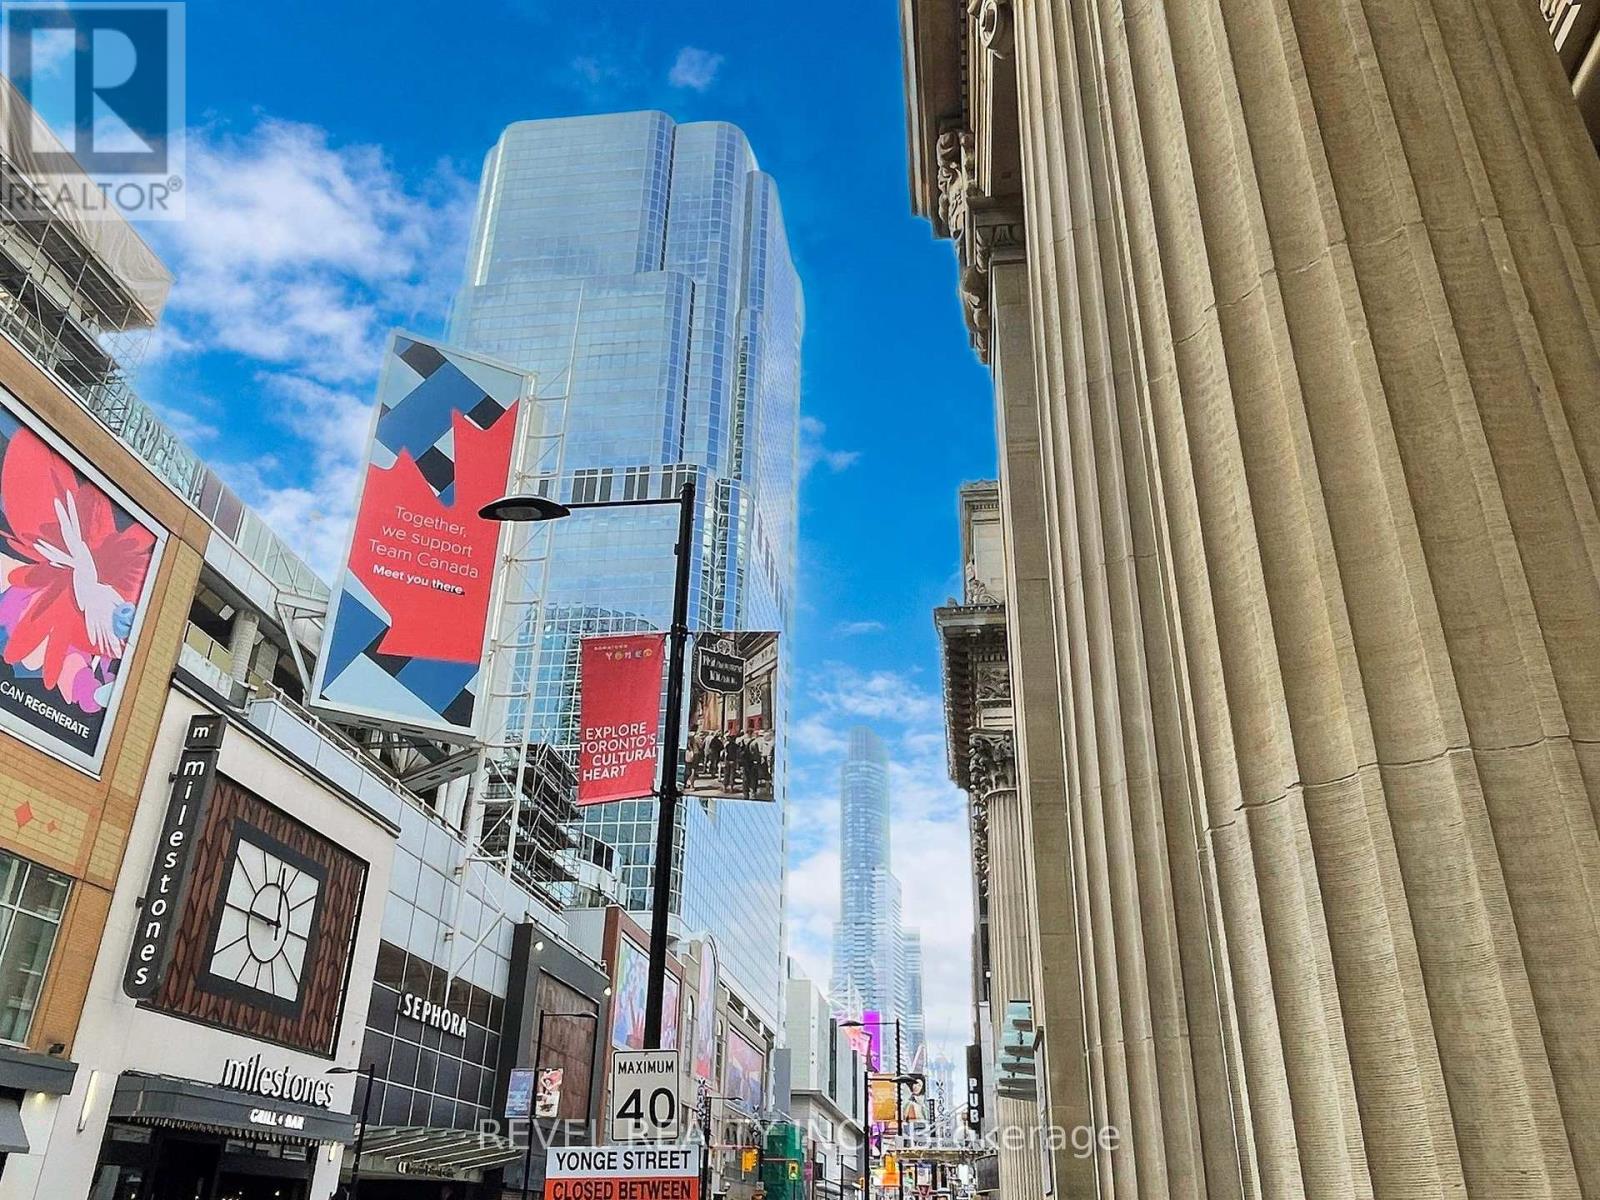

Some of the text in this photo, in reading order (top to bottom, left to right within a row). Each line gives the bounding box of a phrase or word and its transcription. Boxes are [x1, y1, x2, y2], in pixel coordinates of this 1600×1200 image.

[394, 505, 467, 538] Together,
[369, 538, 479, 578] Team Canada
[382, 525, 473, 558] we support
[373, 564, 405, 580] Meet
[406, 573, 429, 585] you
[0, 681, 90, 739] CAN REGENERATE
[580, 732, 657, 754] TORONTO'S
[586, 721, 647, 741] EXPLORE
[583, 764, 628, 782] HEART
[592, 747, 657, 767] CULTURAL
[134, 759, 205, 986] milestones
[402, 993, 467, 1039] SEPHORA
[221, 1053, 335, 1107] milestones
[618, 1060, 674, 1075] MAXIMUM
[616, 1087, 675, 1129] 40
[968, 1077, 980, 1124] PUB
[556, 1150, 691, 1171] YONGE STREET
[553, 1180, 691, 1200] CLOSED BETWEEN
